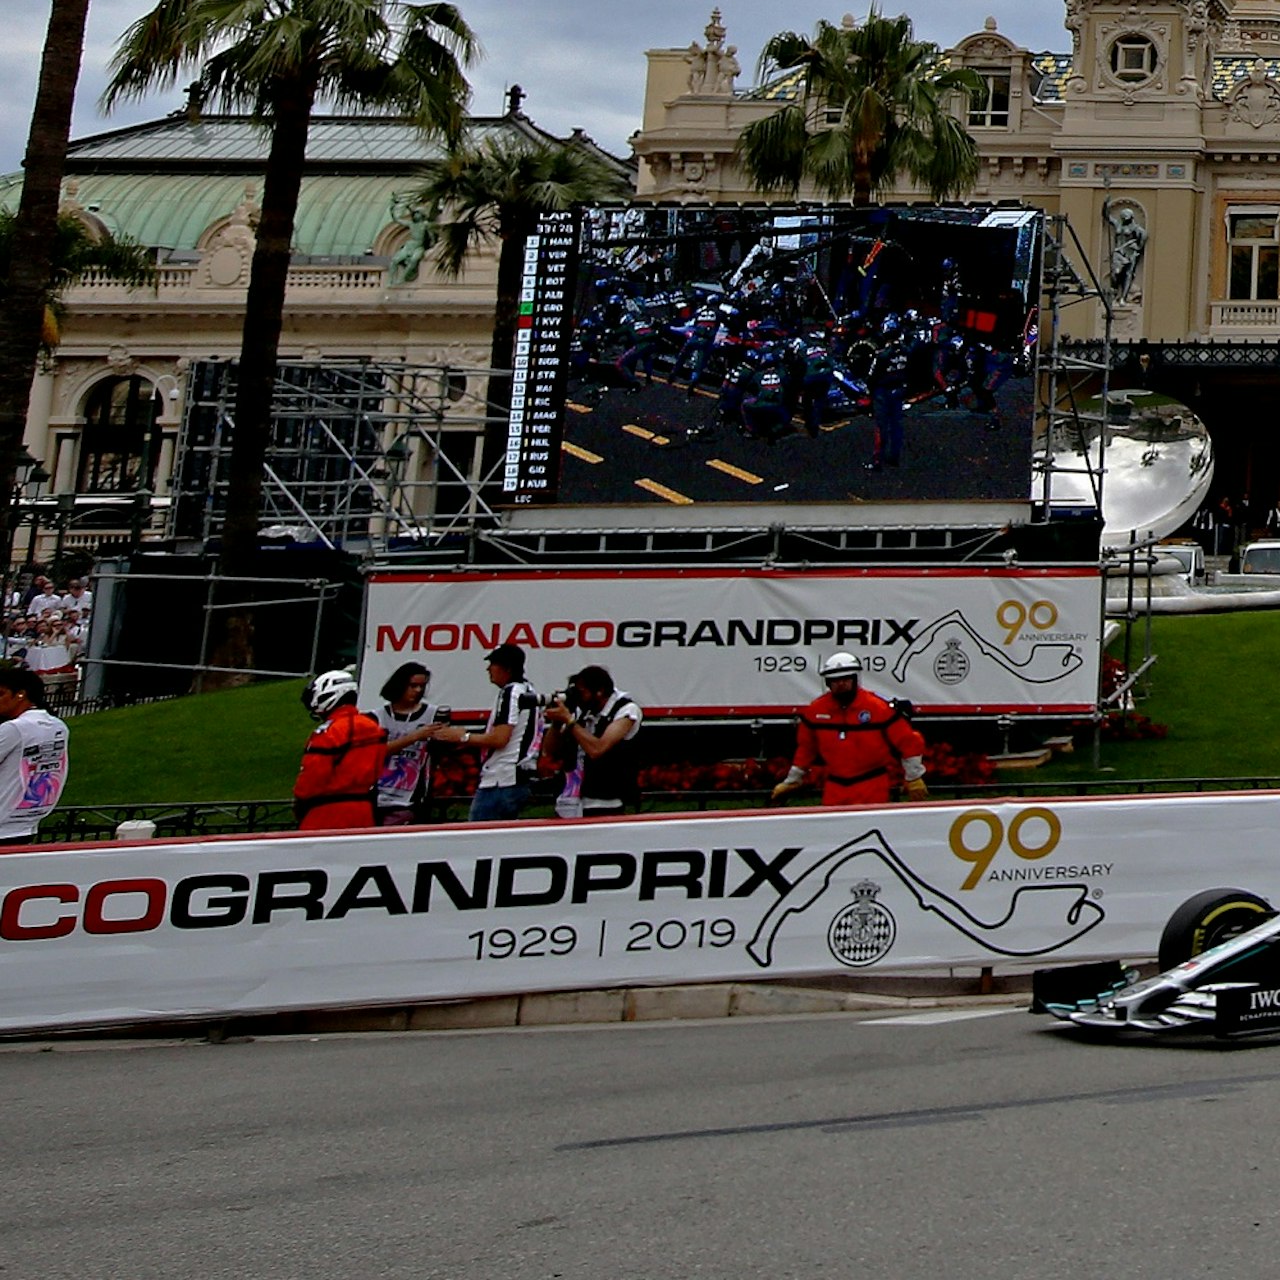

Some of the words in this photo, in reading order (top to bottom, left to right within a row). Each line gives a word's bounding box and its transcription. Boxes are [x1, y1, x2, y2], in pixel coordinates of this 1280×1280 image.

[547, 264, 566, 273] VET
[541, 330, 560, 339] GAS
[528, 465, 546, 474] GIO
[996, 600, 1059, 646] 90
[376, 619, 920, 652] MONACOGRANDPRIX
[1018, 632, 1088, 642] ANNIVERSARY
[754, 656, 808, 672] 1929
[948, 807, 1062, 891] 90
[988, 863, 1114, 882] ANNIVERSARY
[1, 848, 804, 941] COGRANDPRIX
[468, 926, 578, 960] 1929
[626, 919, 736, 951] 2019
